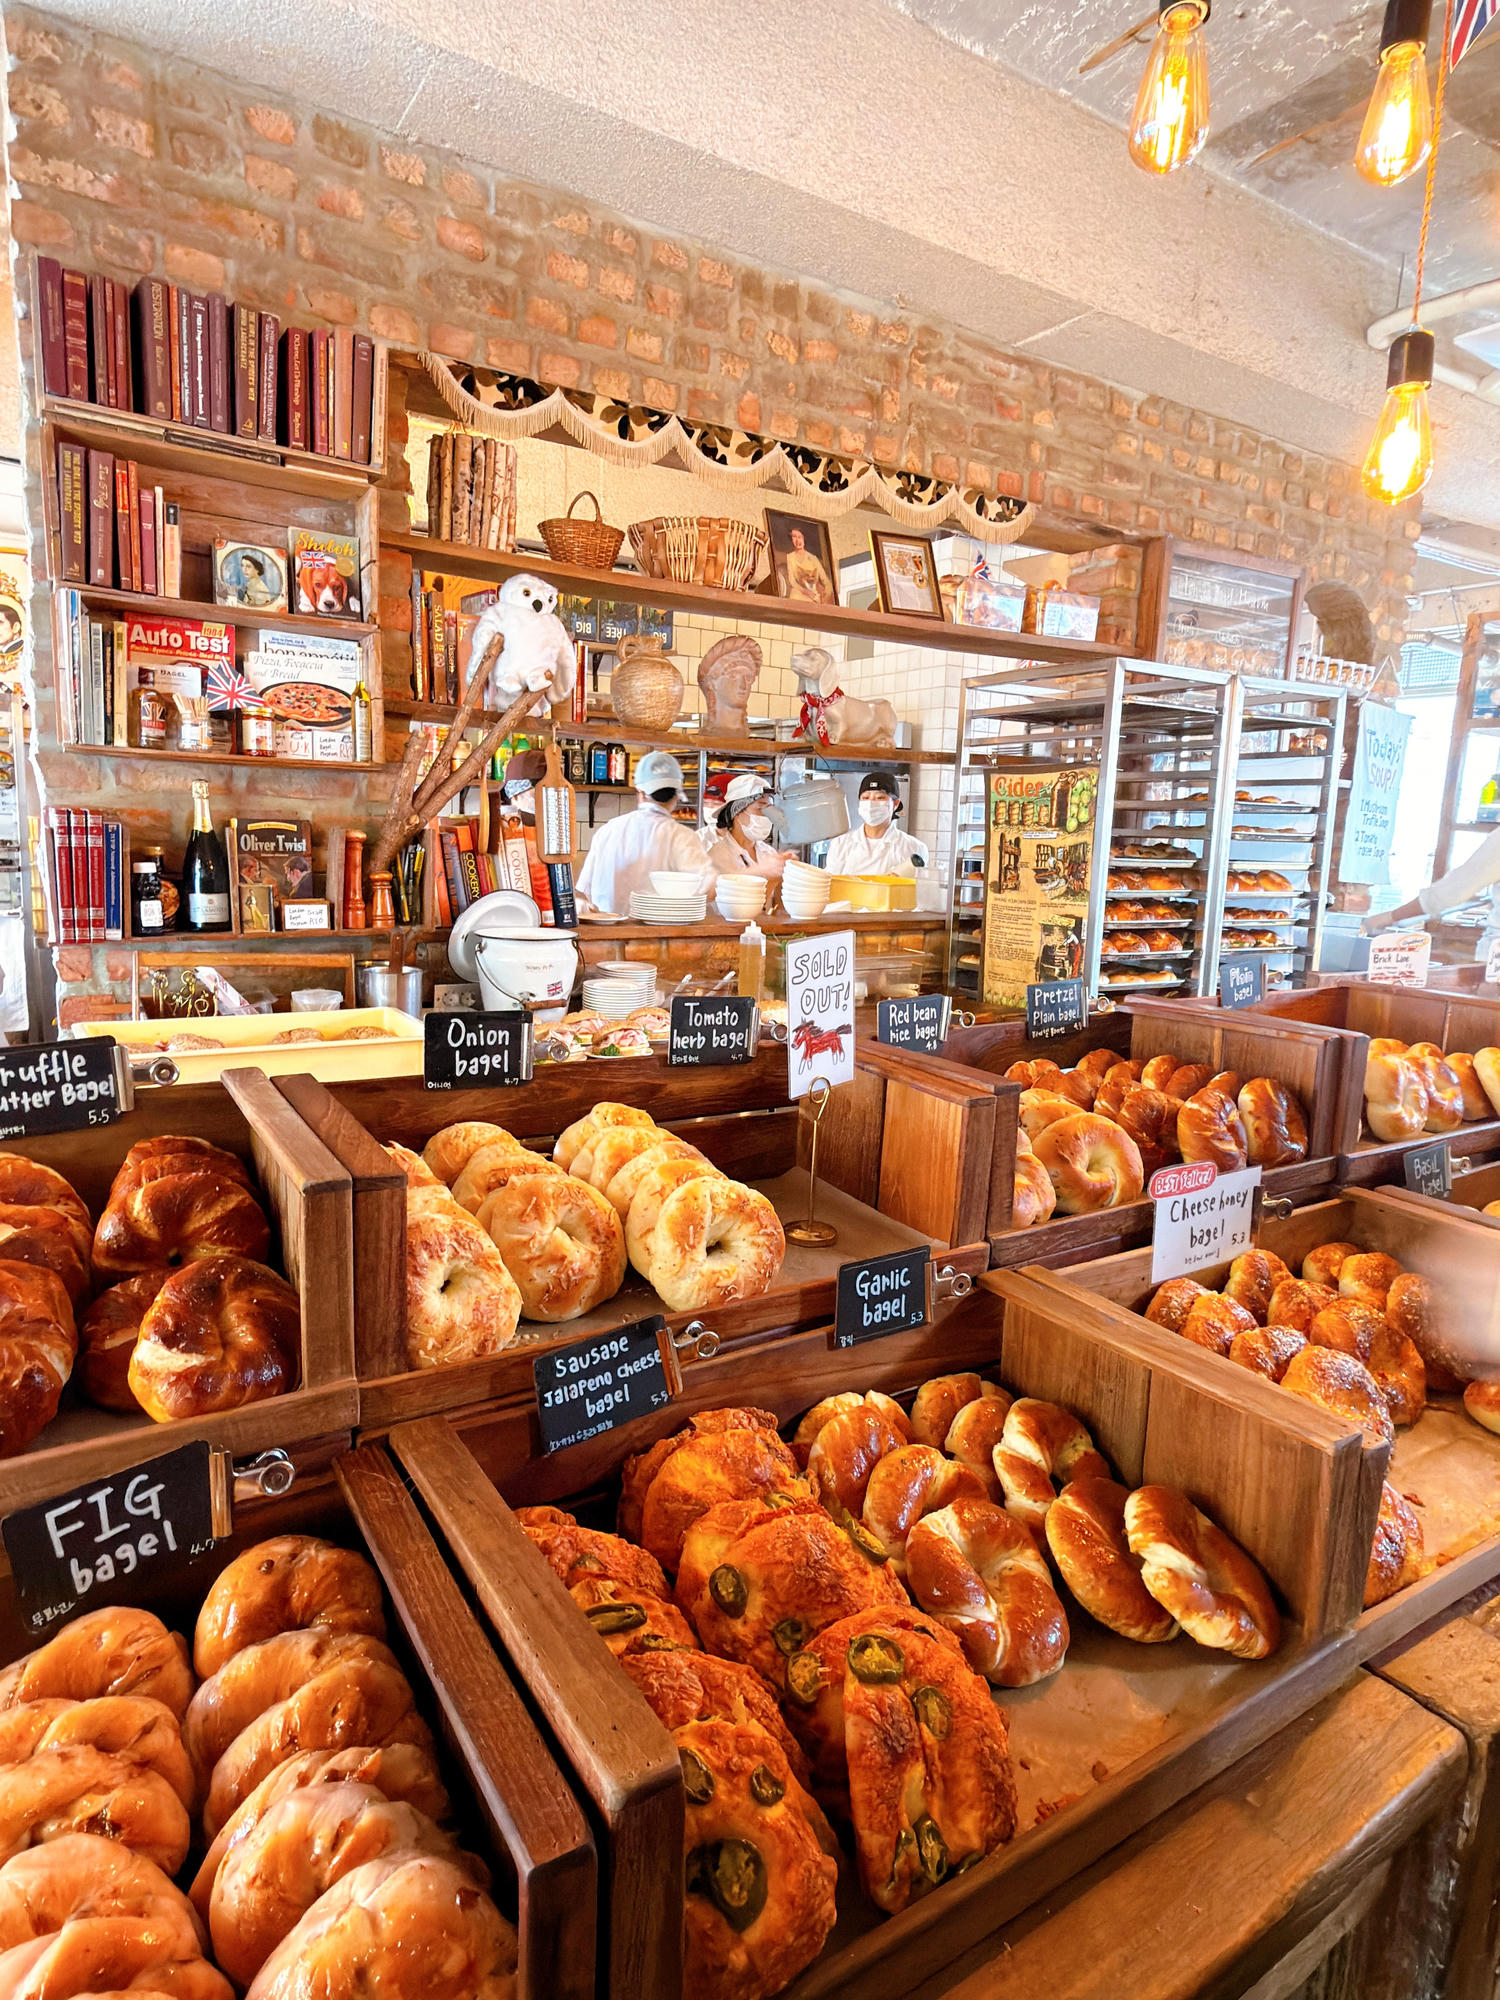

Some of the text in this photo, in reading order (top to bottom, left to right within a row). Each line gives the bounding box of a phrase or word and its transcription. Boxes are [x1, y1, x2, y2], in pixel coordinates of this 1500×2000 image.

[296, 532, 357, 557] Shiloh
[203, 626, 223, 637] 1984
[434, 604, 444, 642] SALAD
[575, 621, 592, 634] BIG
[130, 624, 230, 653] Auto Test
[160, 669, 186, 678] BAGEL
[269, 669, 301, 679] Bread
[993, 774, 1044, 799] Cider
[240, 833, 307, 852] Oliver Twist
[465, 852, 480, 899] COOKERY
[510, 850, 524, 891] COOKI
[791, 946, 848, 985] SOLD
[1229, 966, 1254, 988] Plain
[799, 980, 851, 1016] OUT!
[1034, 983, 1078, 1007] Pretzel
[684, 1001, 740, 1027] Tomato
[889, 1003, 937, 1027] Red bean
[1033, 1007, 1081, 1026] Plain bagel
[447, 1018, 510, 1048] Onion
[672, 1027, 749, 1051] herb bagel
[889, 1022, 938, 1043] rice bagel
[455, 1050, 510, 1077] bagel
[0, 1073, 116, 1113] utter Bagel
[427, 1081, 452, 1090] 어니언
[504, 1077, 519, 1085] 4.7
[88, 1107, 110, 1125] 5.5
[1154, 1172, 1180, 1195] BEST
[1170, 1189, 1249, 1223] Cheese honey
[1189, 1218, 1225, 1249] bagel
[855, 1267, 911, 1300] Garlic
[862, 1293, 906, 1327] bagel
[910, 1311, 924, 1325] 5.3
[554, 1335, 630, 1378] Sausage
[585, 1383, 631, 1418] bagel
[650, 1390, 669, 1406] 5.5
[45, 1473, 166, 1559] FIG
[70, 1519, 178, 1596] bagel
[190, 1537, 216, 1555] 4.7
